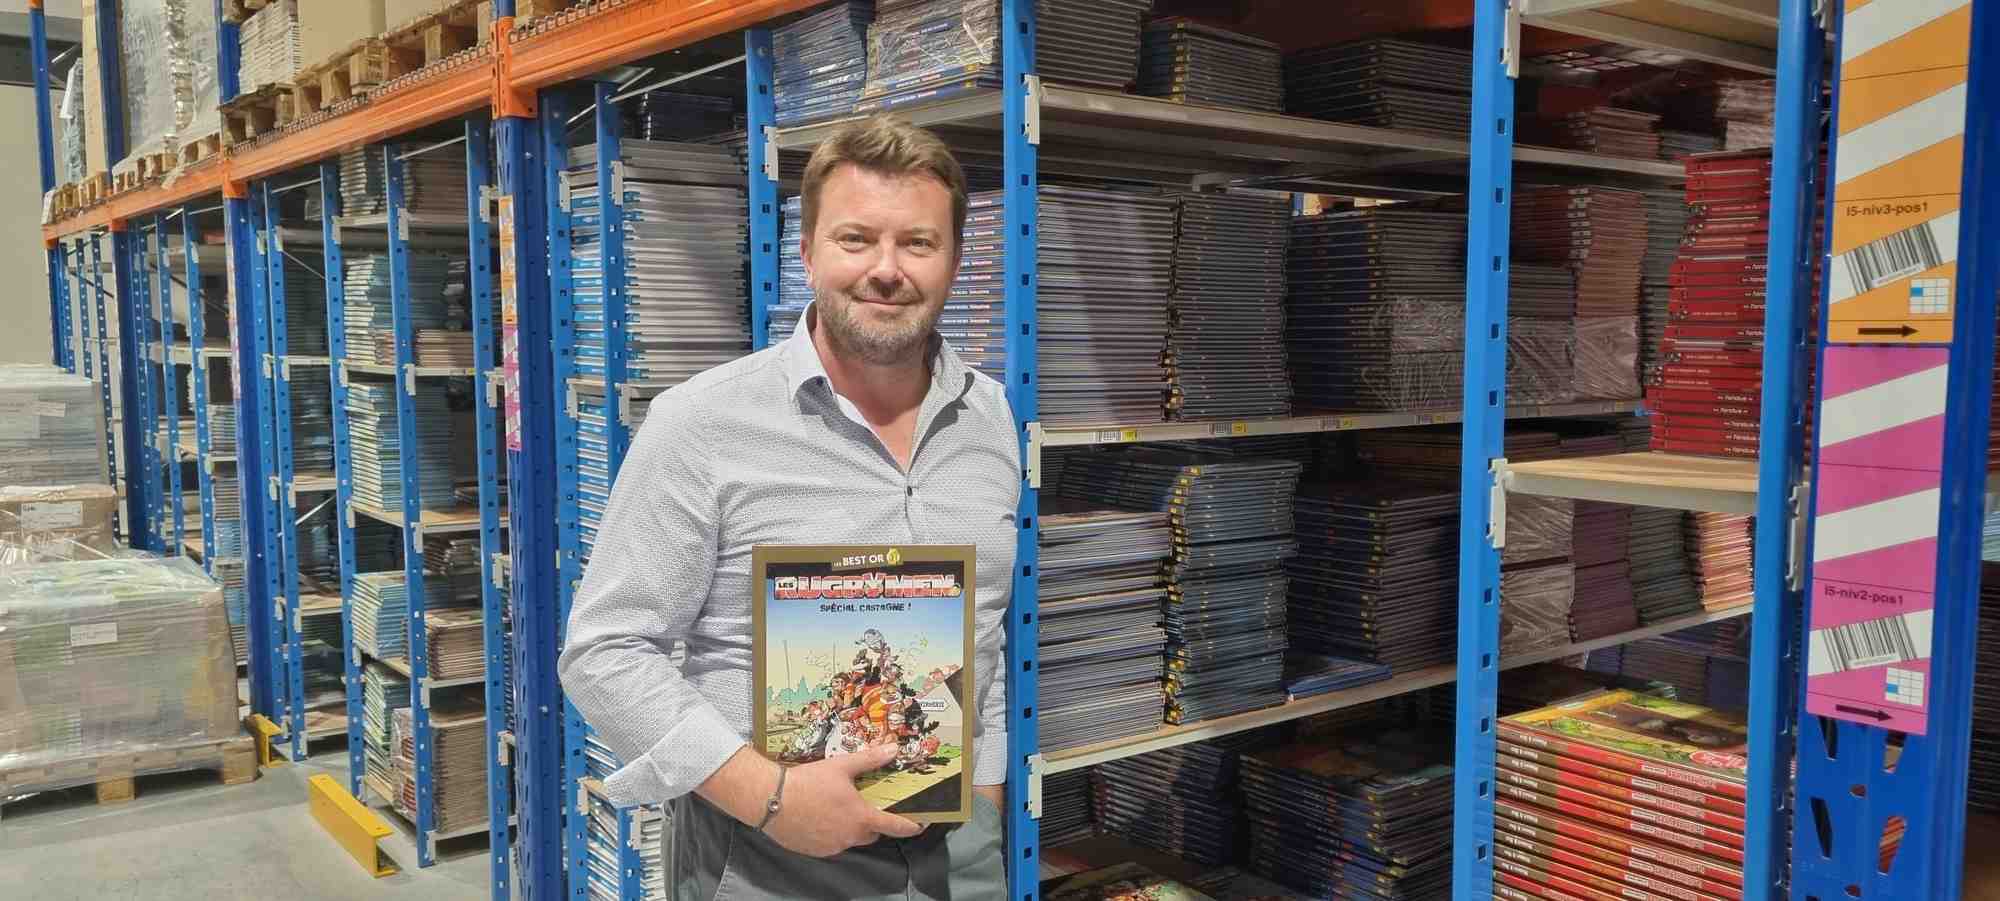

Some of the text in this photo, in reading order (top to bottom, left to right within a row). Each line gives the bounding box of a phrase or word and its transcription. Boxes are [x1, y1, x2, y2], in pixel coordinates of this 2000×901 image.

[842, 555, 866, 567] BEST
[868, 554, 884, 564] OR
[774, 572, 956, 600] RUGBYMEN
[820, 602, 856, 613] SPÉCIAL
[859, 603, 905, 612] CASTAGNE
